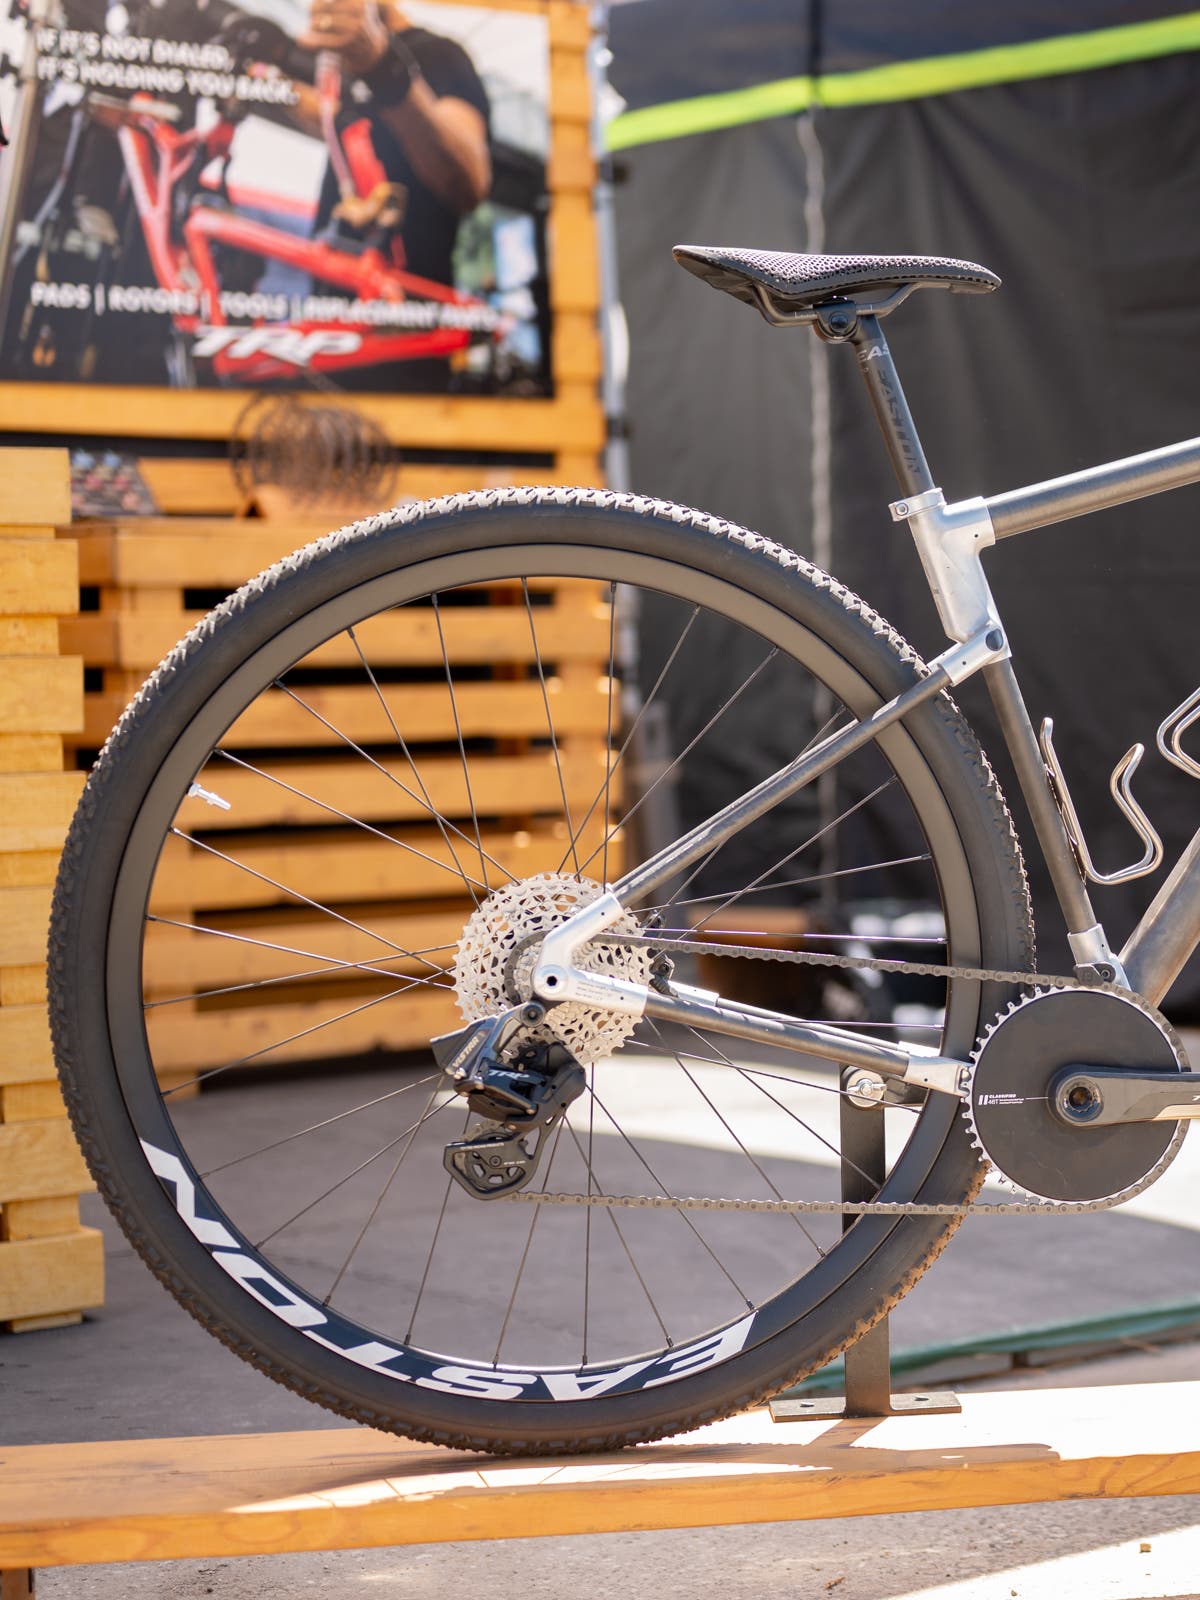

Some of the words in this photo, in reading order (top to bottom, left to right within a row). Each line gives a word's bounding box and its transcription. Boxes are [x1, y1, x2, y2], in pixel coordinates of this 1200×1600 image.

[37, 27, 58, 51] IF
[59, 31, 100, 57] IT'S
[102, 34, 150, 62] NOT
[37, 56, 78, 81] IT'S
[80, 60, 184, 93] HOLDING
[185, 70, 235, 98] YOU
[31, 281, 91, 310] PADS
[108, 285, 197, 315] ROTORS
[219, 291, 287, 319] TOOLS
[192, 325, 362, 366] TRP
[453, 1035, 480, 1068] VISTAR
[487, 1069, 530, 1079] TRP
[139, 1137, 760, 1402] EASTON
